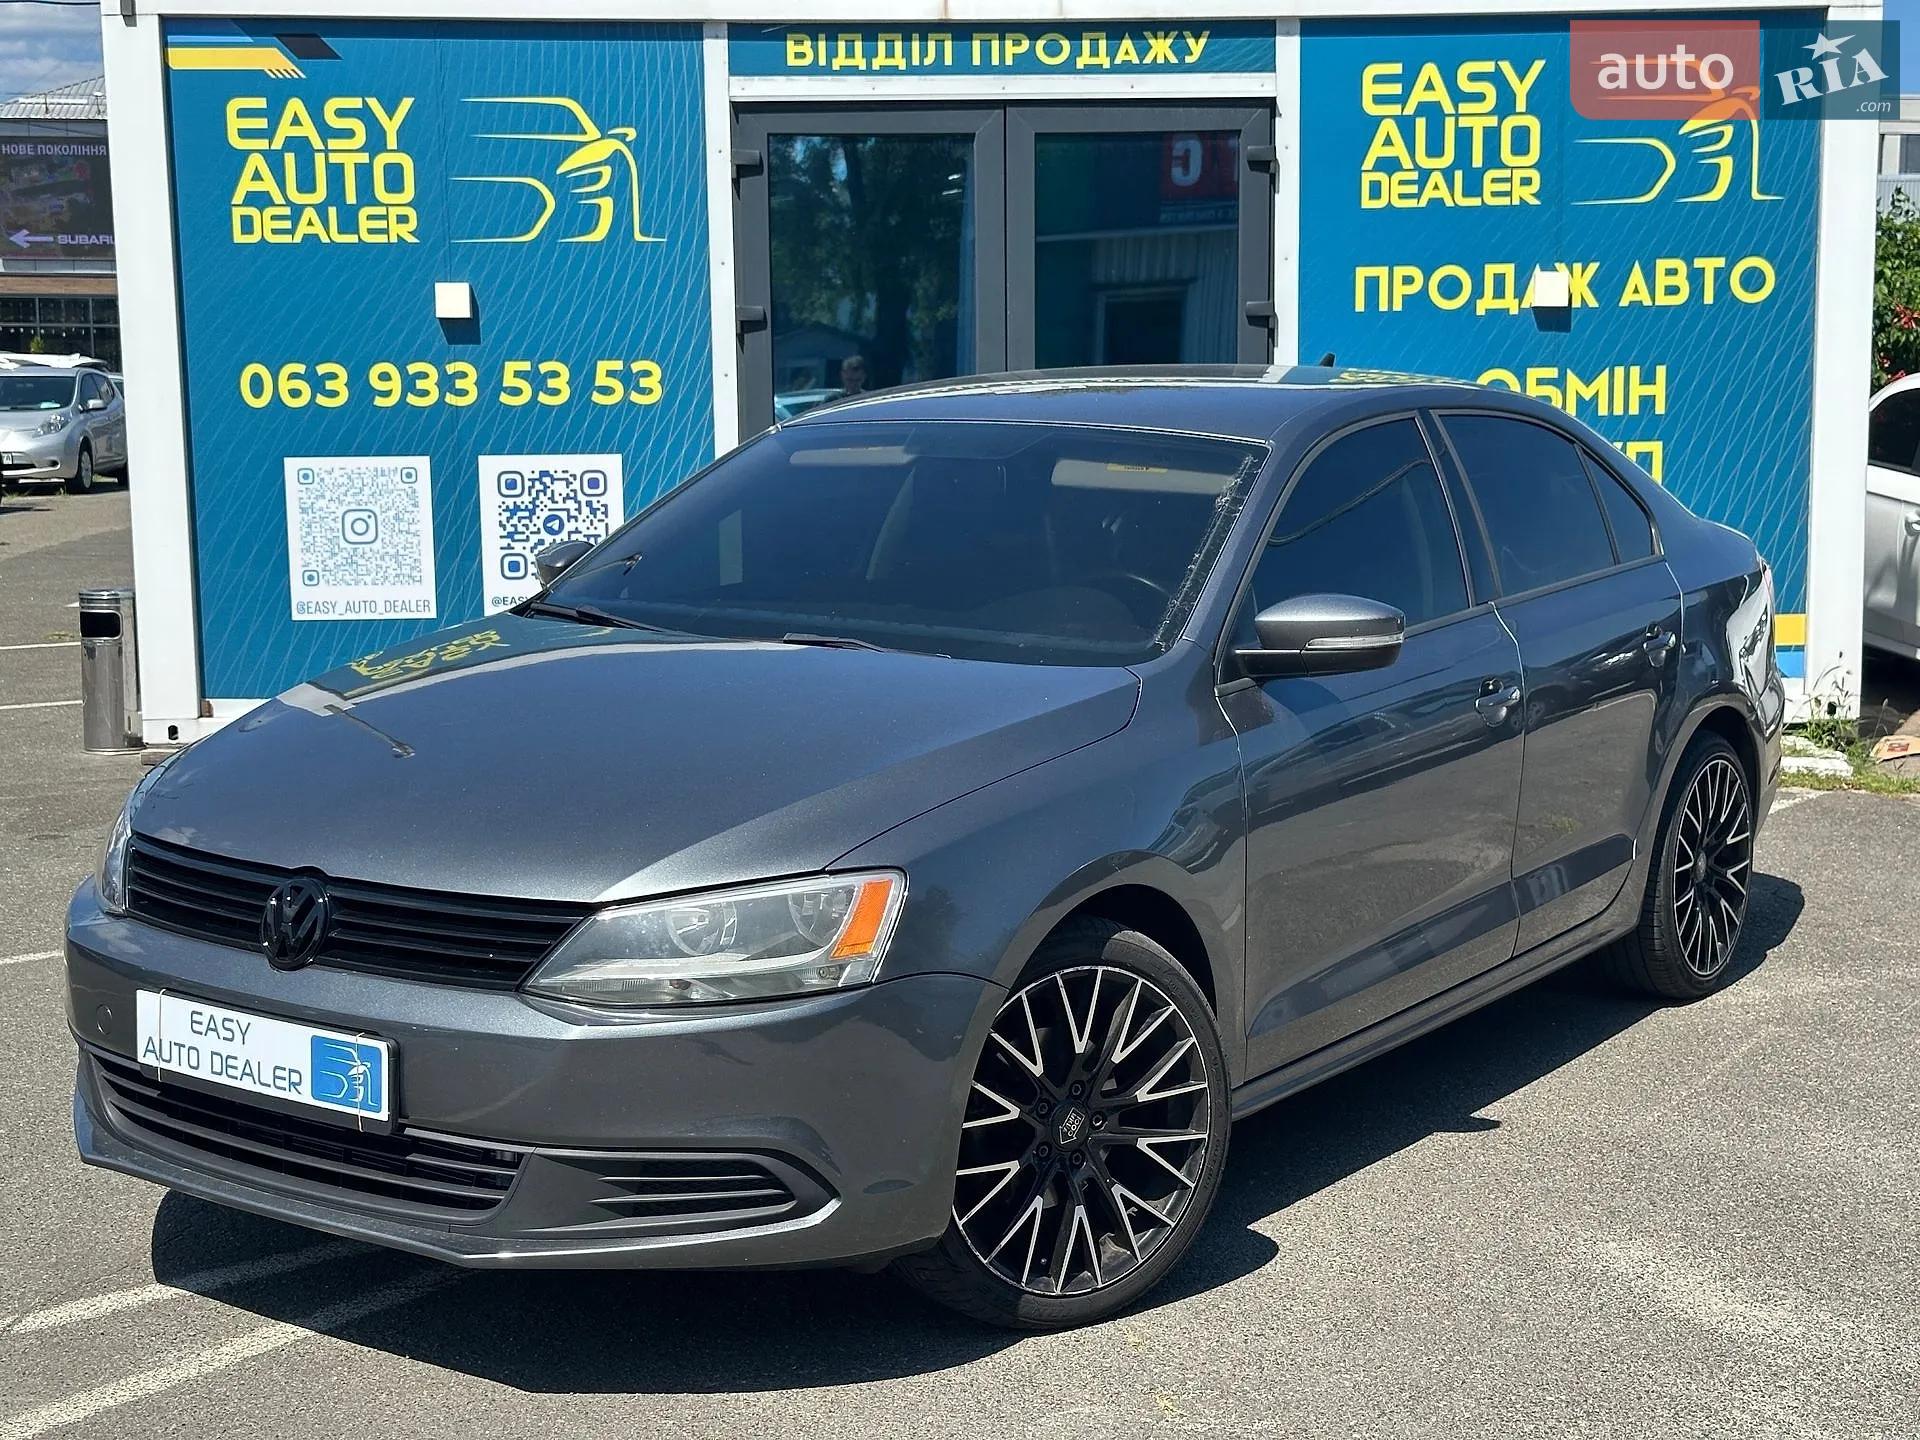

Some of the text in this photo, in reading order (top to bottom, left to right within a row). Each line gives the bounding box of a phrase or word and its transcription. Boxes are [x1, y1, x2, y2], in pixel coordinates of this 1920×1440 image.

[786, 31, 1211, 70] ВІДДІЛ ПРОДАЖУ
[1361, 60, 1546, 116] EASY
[225, 97, 414, 150] EASY
[1361, 115, 1542, 169] AUTO
[2, 144, 107, 156] НОВЕ ПОКОЛІННЯ
[231, 151, 416, 205] AUTO
[1360, 168, 1541, 208] DEALER
[231, 206, 419, 243] DEALER
[1620, 256, 1777, 306] АВТО
[239, 360, 663, 408] 063 933 53 53
[297, 599, 431, 616] @EASY_AUTO_DEALER
[491, 596, 528, 607] @EAS
[190, 1010, 251, 1045] EASY
[143, 1036, 303, 1095] AUTO DEALER
